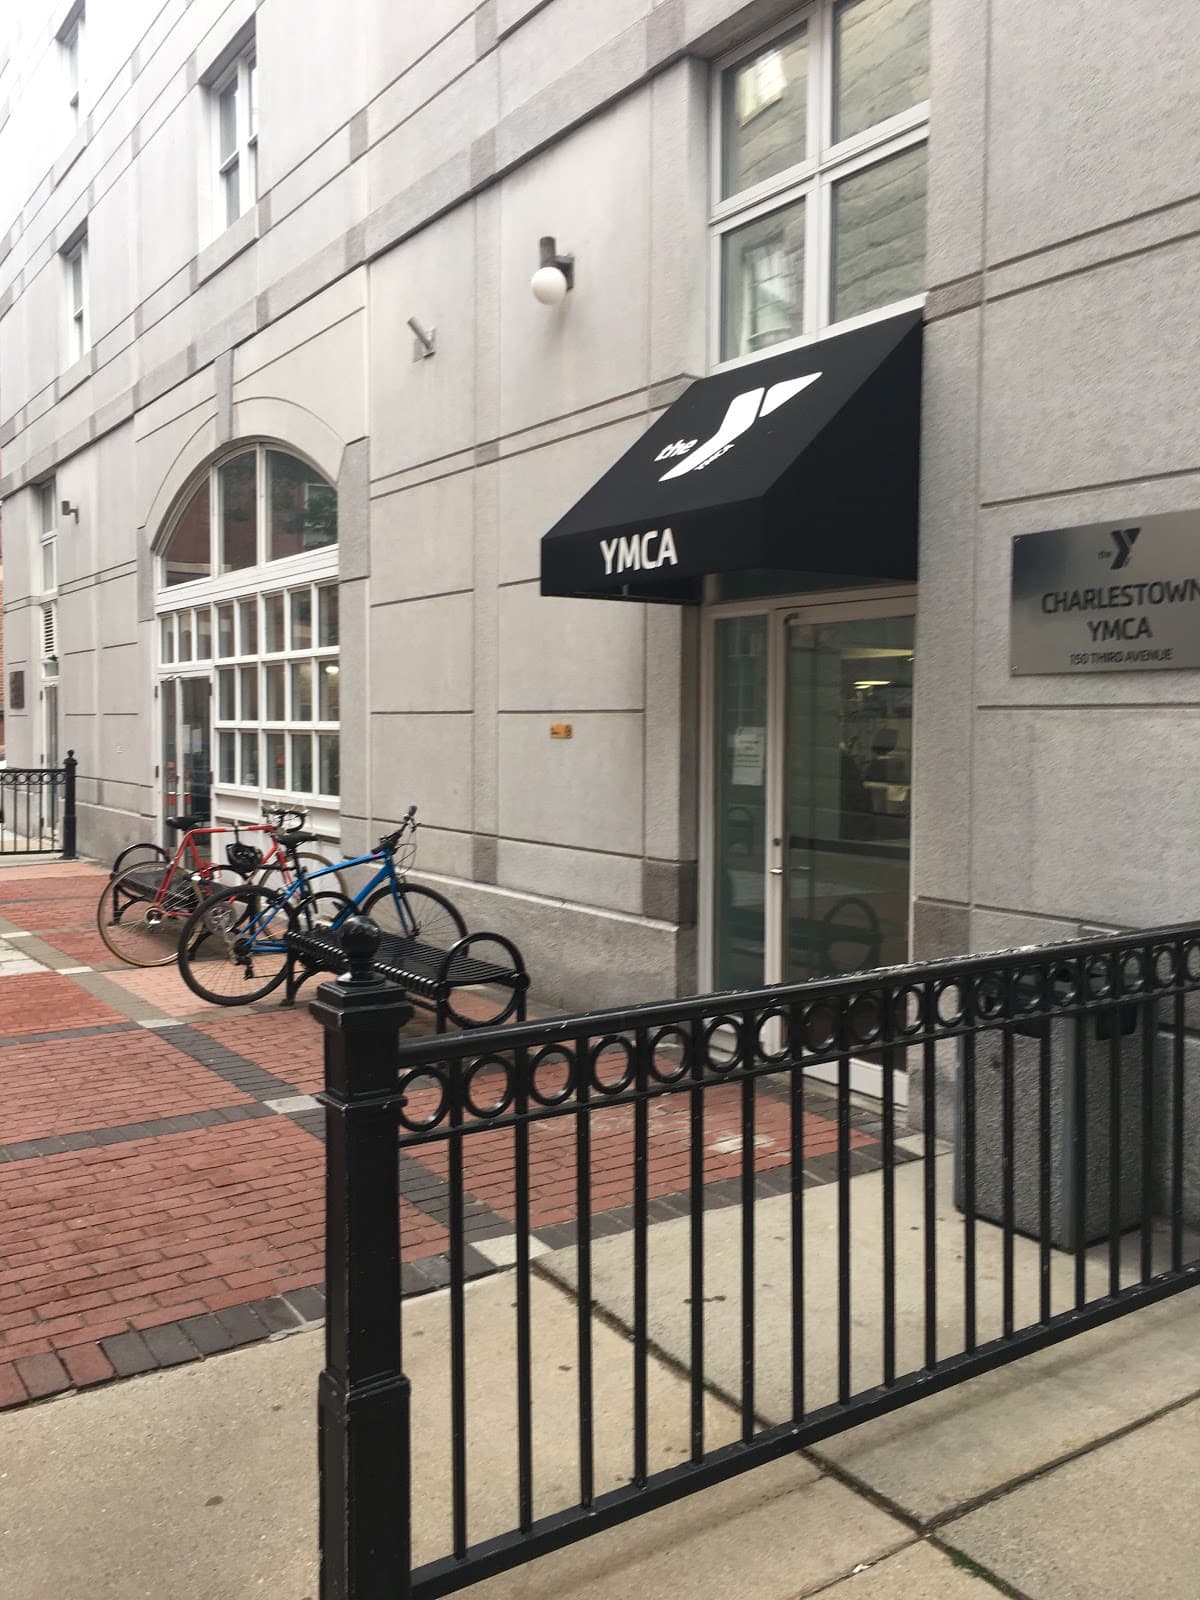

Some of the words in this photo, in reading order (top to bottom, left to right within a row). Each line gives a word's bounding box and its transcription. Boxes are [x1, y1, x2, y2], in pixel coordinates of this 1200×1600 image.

[654, 439, 698, 462] the
[600, 527, 679, 576] YMCA
[1041, 578, 1200, 614] CHARLESTOWN
[1087, 616, 1153, 642] YMCA
[1123, 648, 1174, 663] AVENUE
